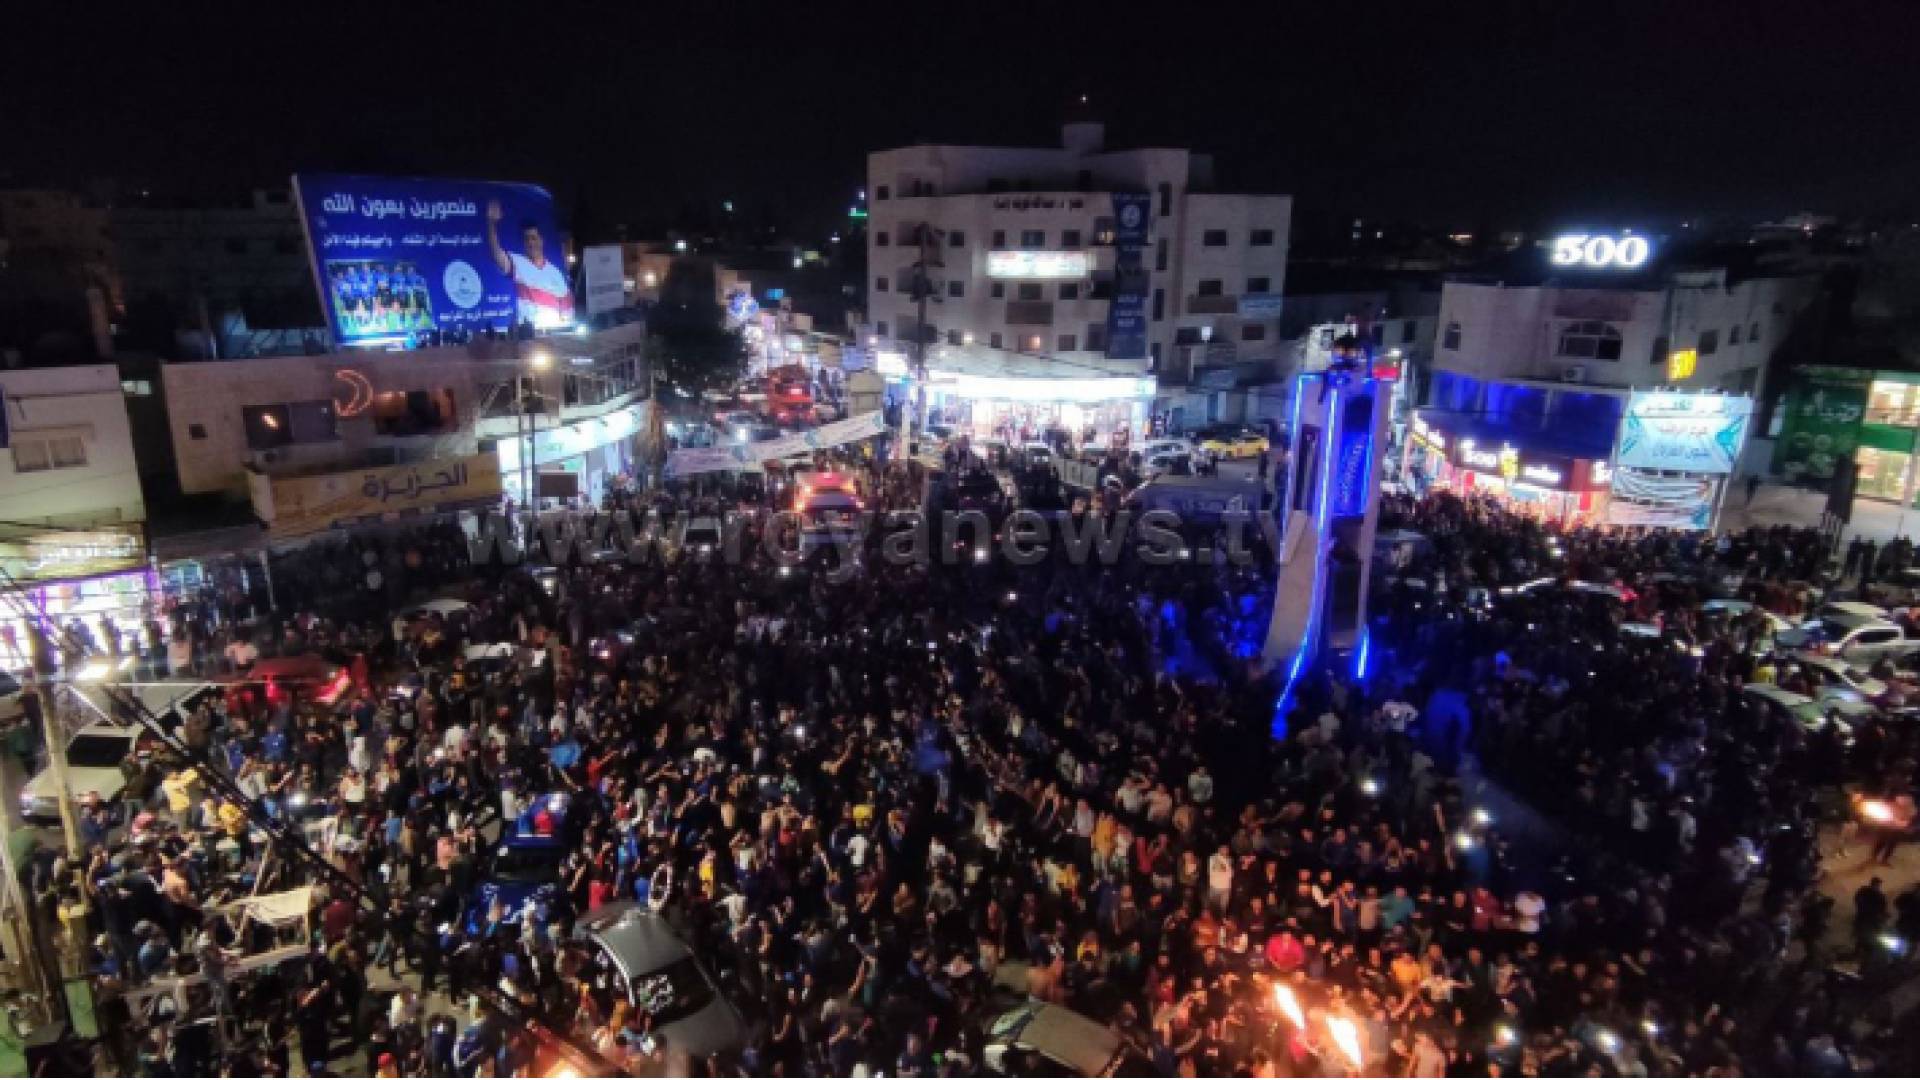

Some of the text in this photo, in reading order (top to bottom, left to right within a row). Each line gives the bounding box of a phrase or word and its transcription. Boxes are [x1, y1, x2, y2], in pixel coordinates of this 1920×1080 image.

[323, 193, 477, 219] منصورين بعون الله
[1552, 234, 1648, 266] 500
[362, 462, 468, 502] الجزيرة
